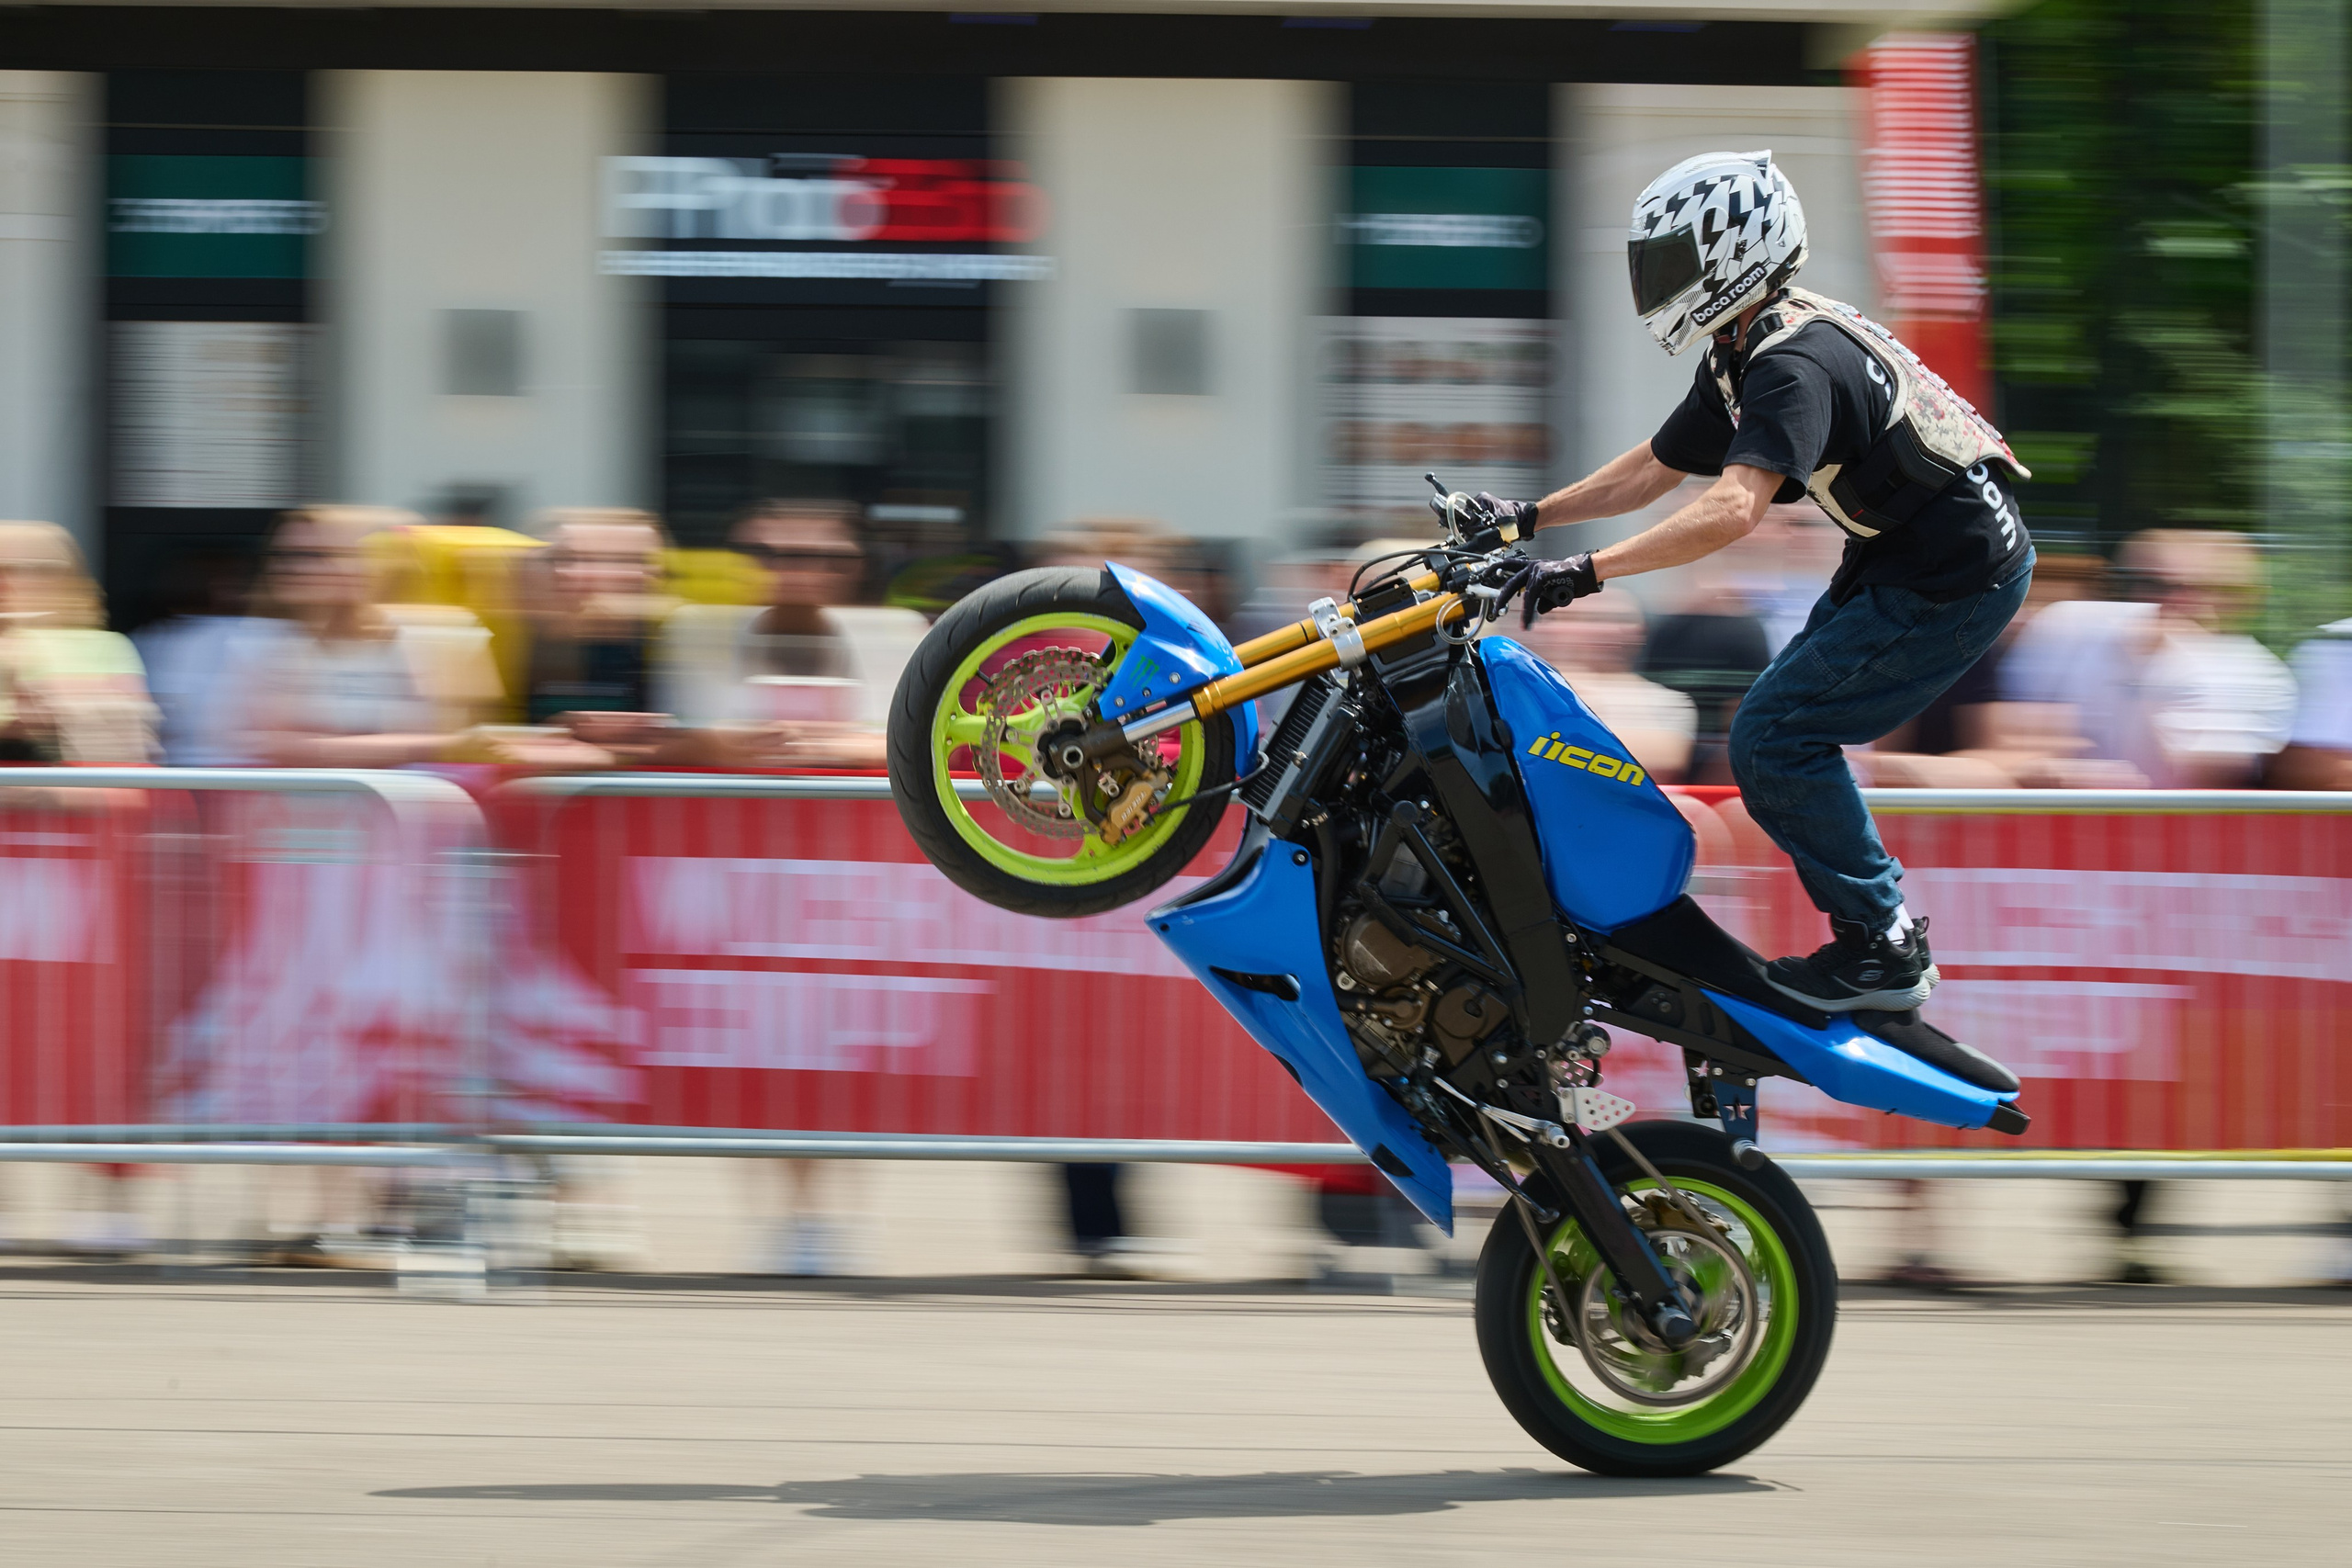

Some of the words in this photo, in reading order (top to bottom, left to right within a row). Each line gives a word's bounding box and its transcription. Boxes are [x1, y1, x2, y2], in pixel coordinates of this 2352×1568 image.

[1692, 296, 1731, 322] boca
[1728, 266, 1765, 299] room
[1966, 462, 2018, 552] oom
